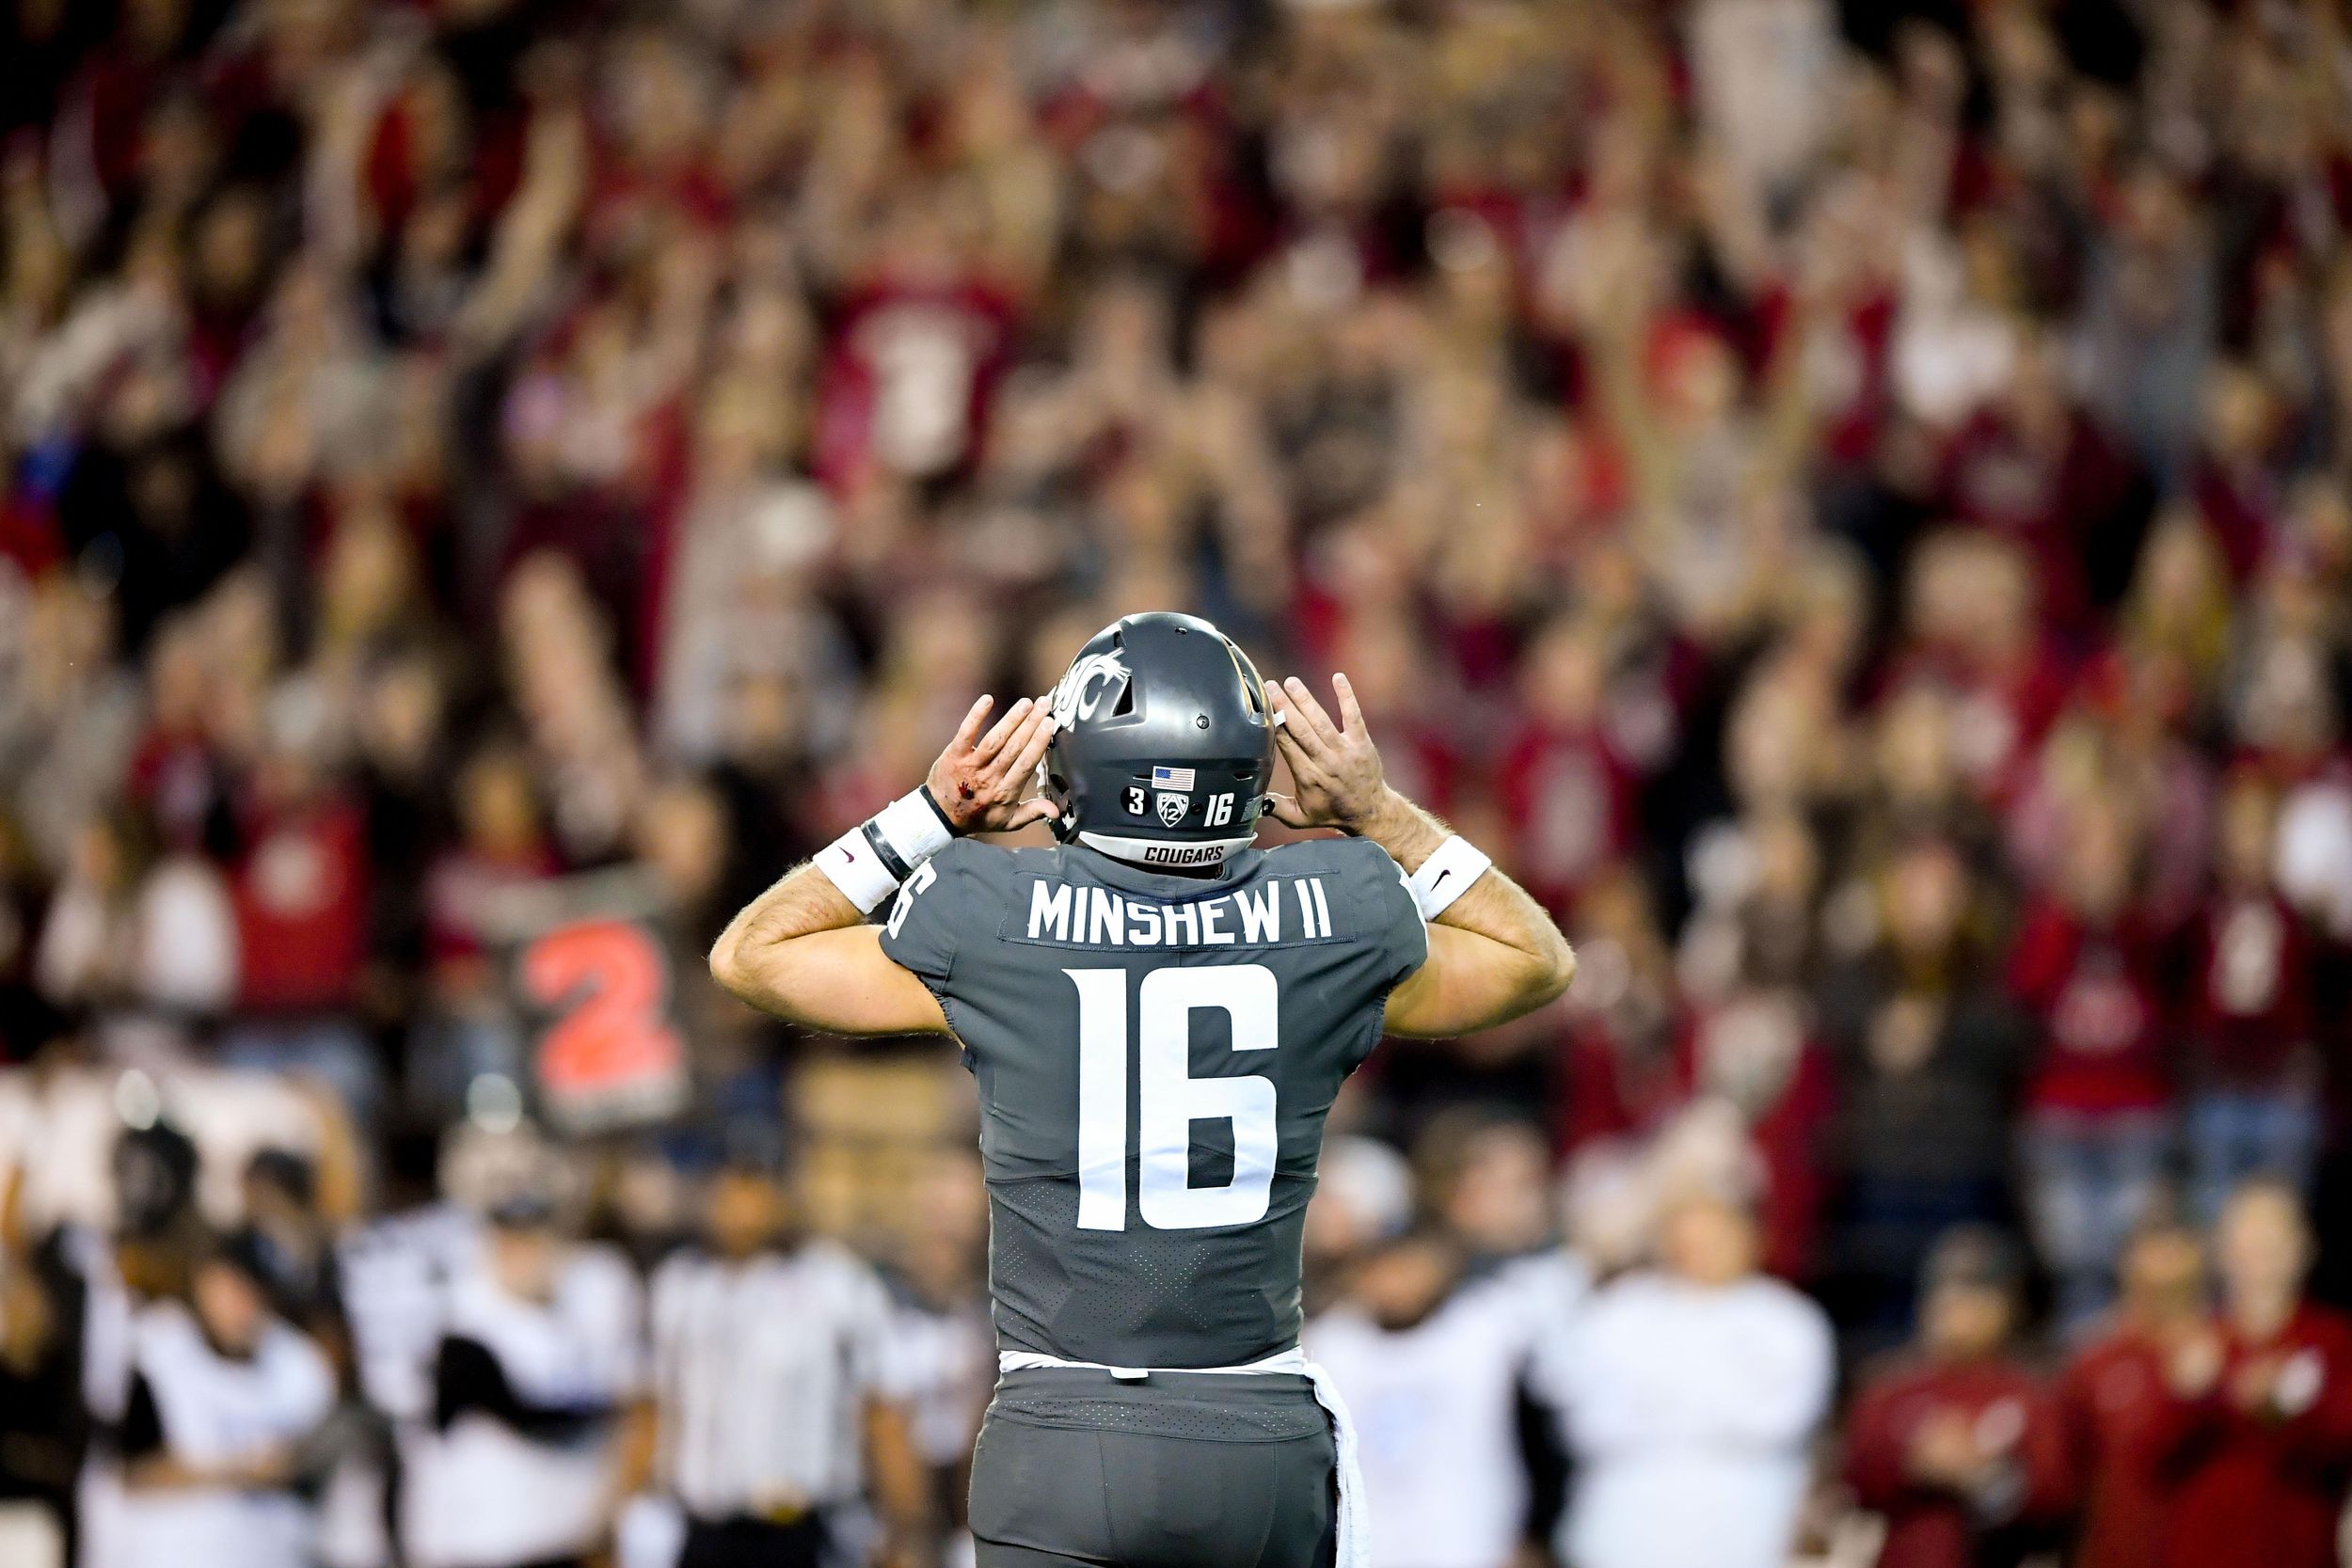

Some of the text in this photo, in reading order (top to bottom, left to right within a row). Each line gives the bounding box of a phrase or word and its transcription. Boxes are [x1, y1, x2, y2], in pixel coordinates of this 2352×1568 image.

[1129, 786, 1145, 816] 3
[1159, 794, 1187, 815] PAC
[1163, 808, 1179, 821] 12
[1203, 792, 1234, 827] 16
[1144, 846, 1224, 864] COUGARS
[1027, 879, 1279, 946] MINSHEW
[1295, 878, 1332, 939] II
[524, 921, 683, 1091] 2
[1061, 963, 1279, 1231] 16
